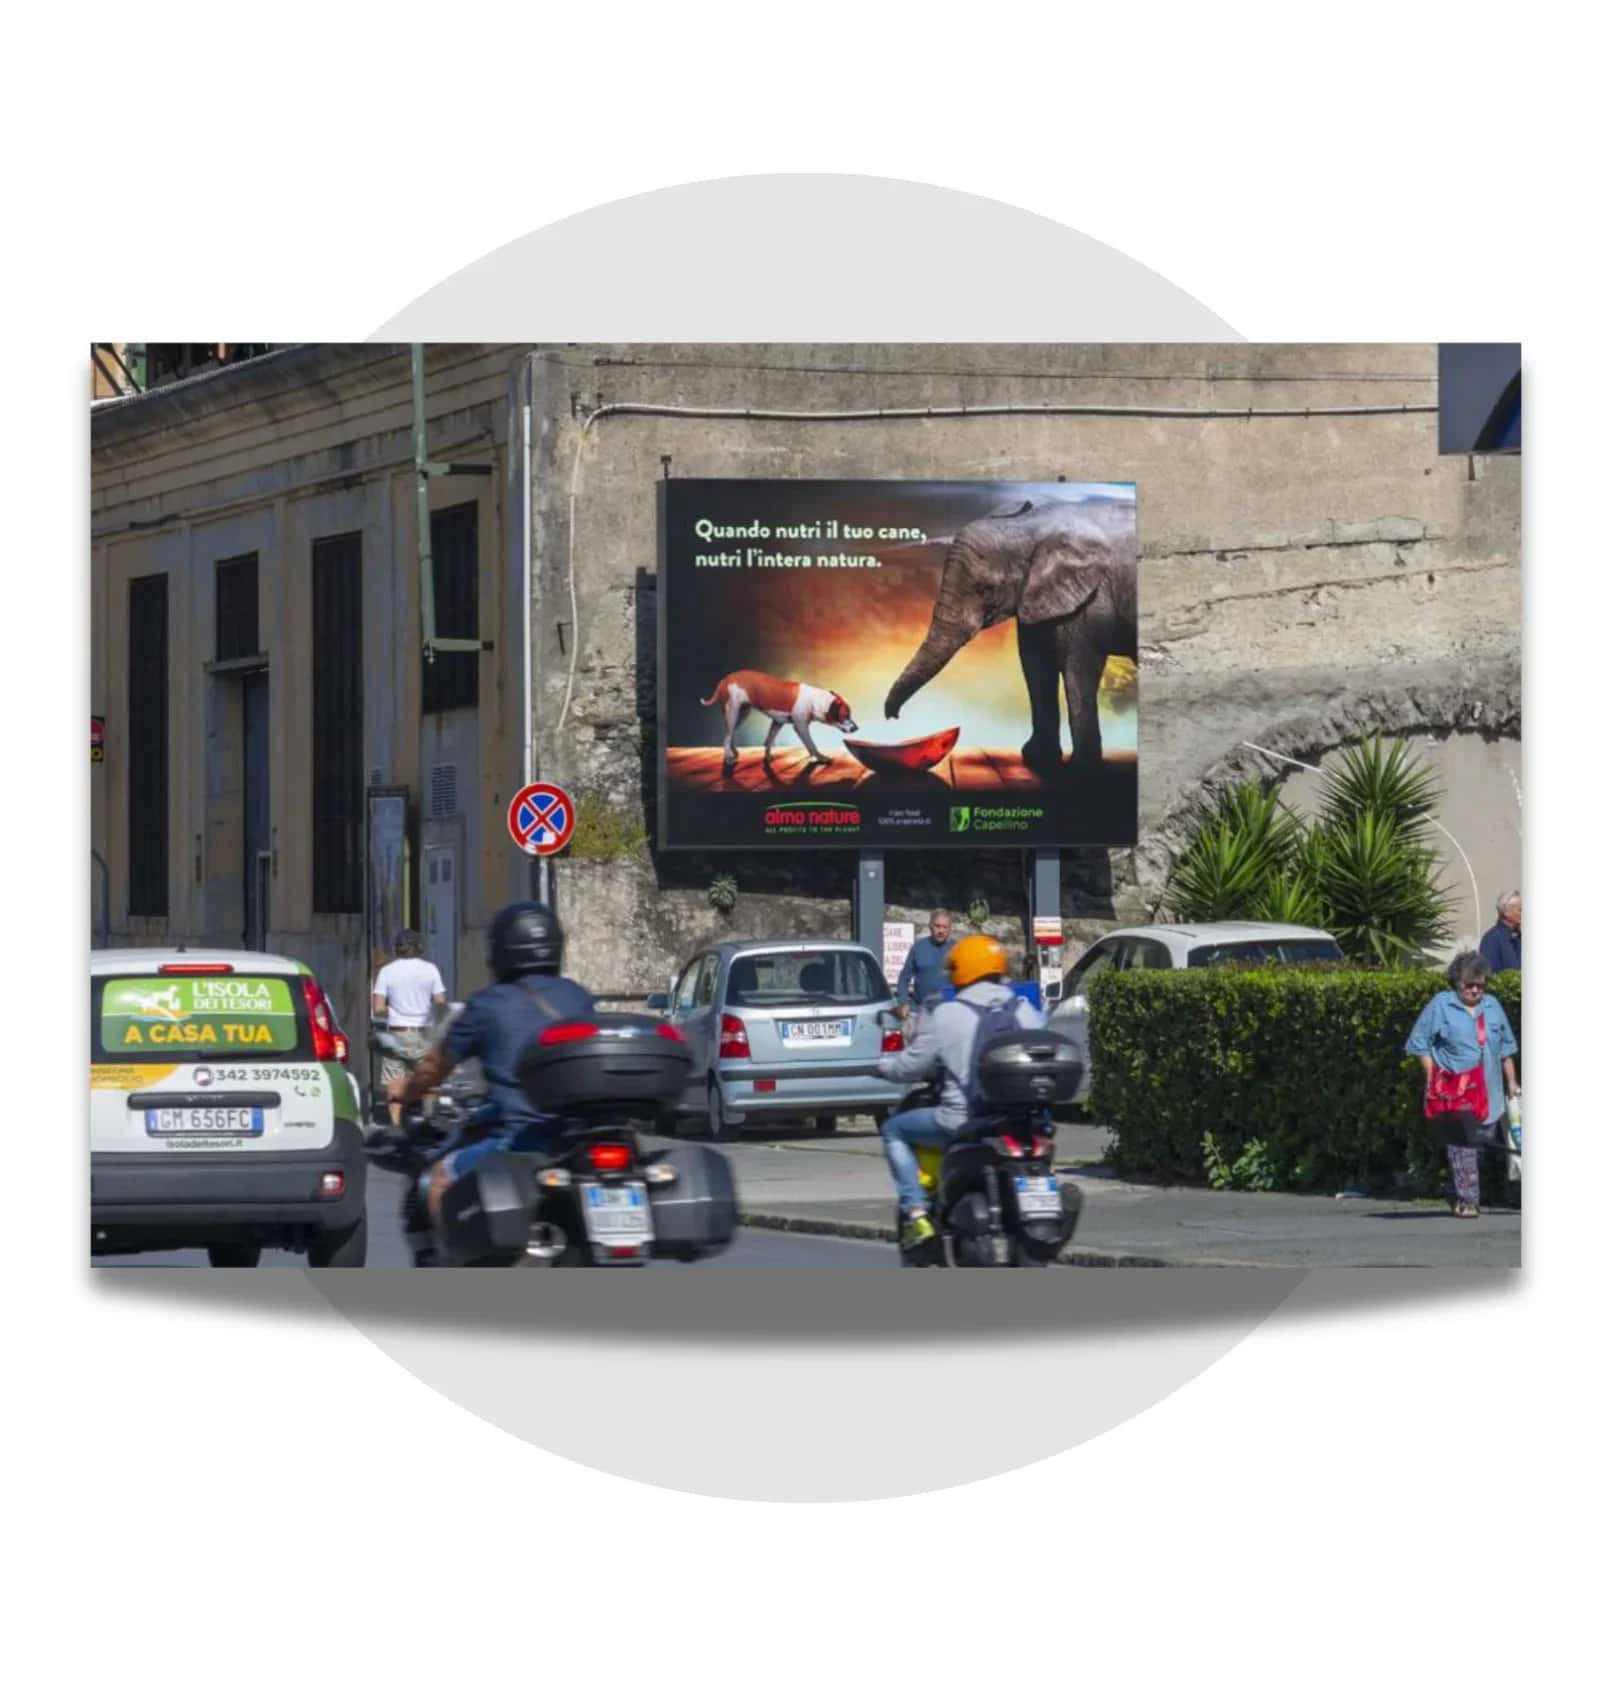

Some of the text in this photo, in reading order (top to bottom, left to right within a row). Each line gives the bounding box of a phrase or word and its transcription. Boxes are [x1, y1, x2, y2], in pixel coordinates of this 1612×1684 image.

[695, 519, 927, 544] Quando nutri il tuo cane,
[695, 548, 882, 568] nutri l'intera natura.
[765, 808, 861, 825] almo nature
[974, 807, 1044, 818] Fondazione
[974, 819, 1029, 831] Capellino
[192, 981, 271, 998] L'ISOLA
[193, 999, 273, 1010] DEI TESORI
[125, 1024, 273, 1043] A CASA TUA
[216, 1068, 321, 1082] 342 3974592
[190, 1109, 250, 1129] 656FC
